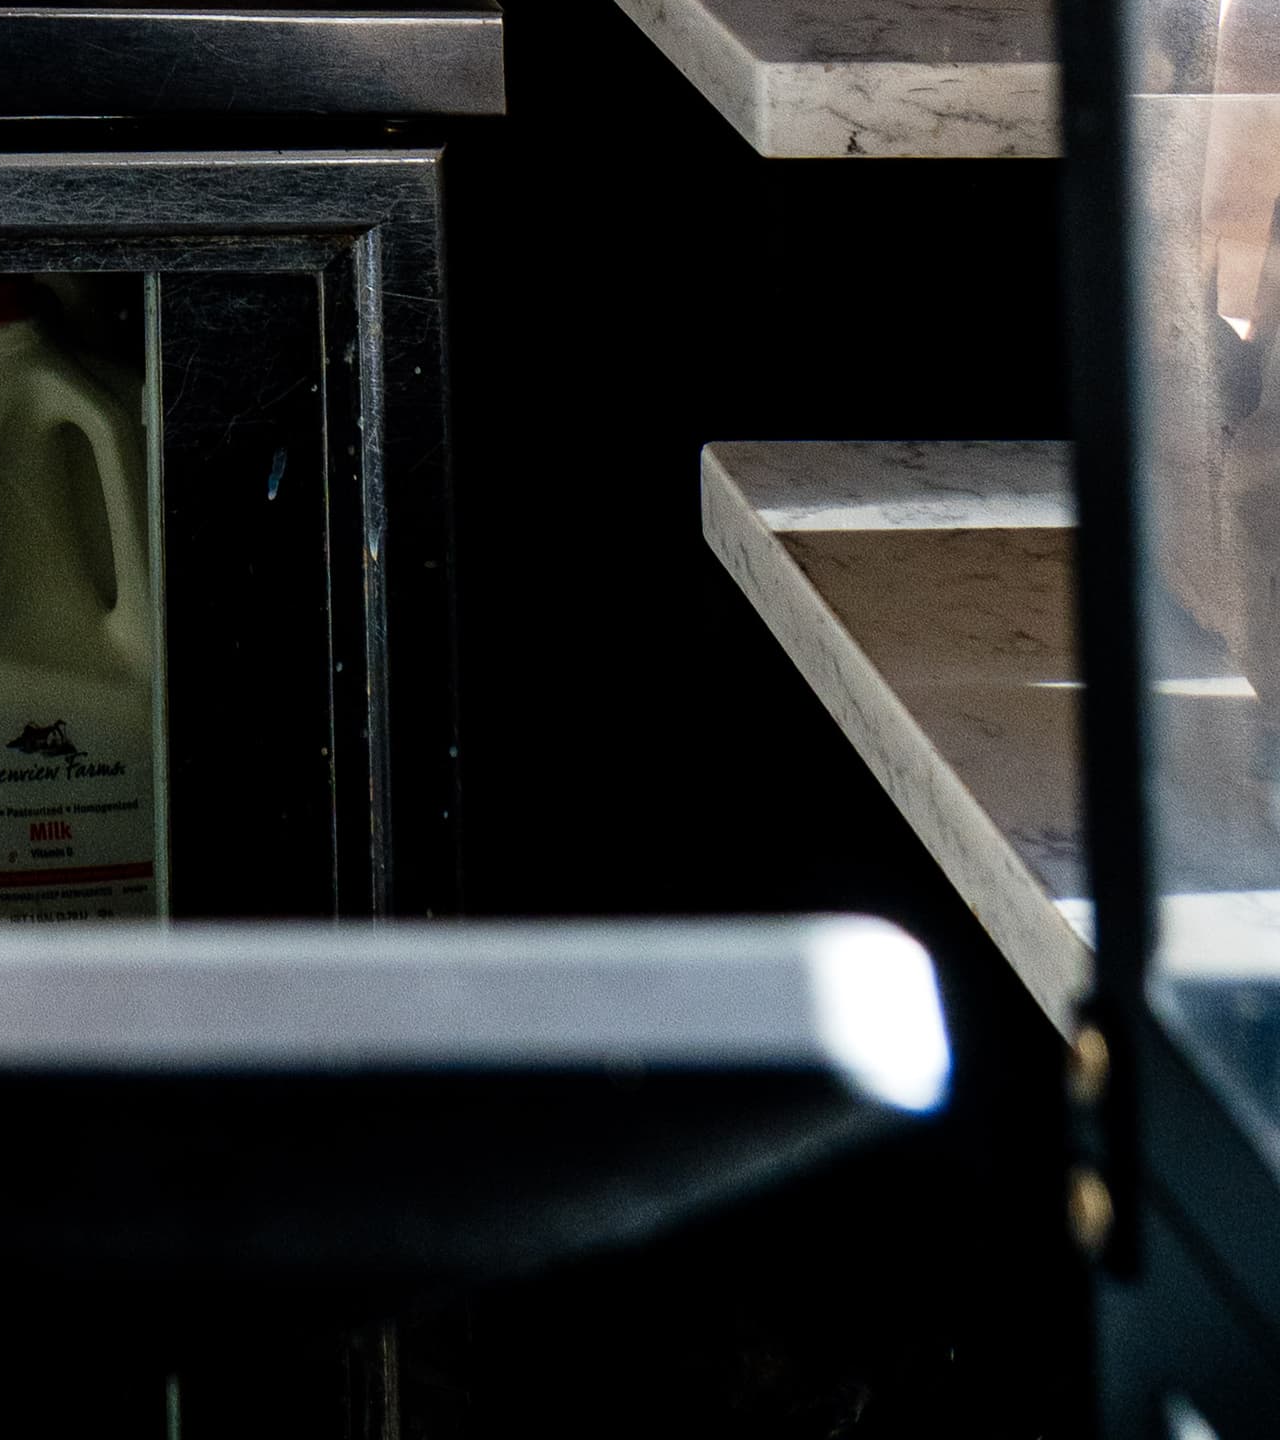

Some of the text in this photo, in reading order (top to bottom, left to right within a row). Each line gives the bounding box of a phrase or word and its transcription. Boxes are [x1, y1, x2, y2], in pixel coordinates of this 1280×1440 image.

[66, 752, 125, 781] Farms
[7, 806, 64, 818] Pasteurized
[73, 800, 139, 814] Homogenized
[29, 821, 73, 842] Milk
[31, 847, 73, 858] Vitamin D
